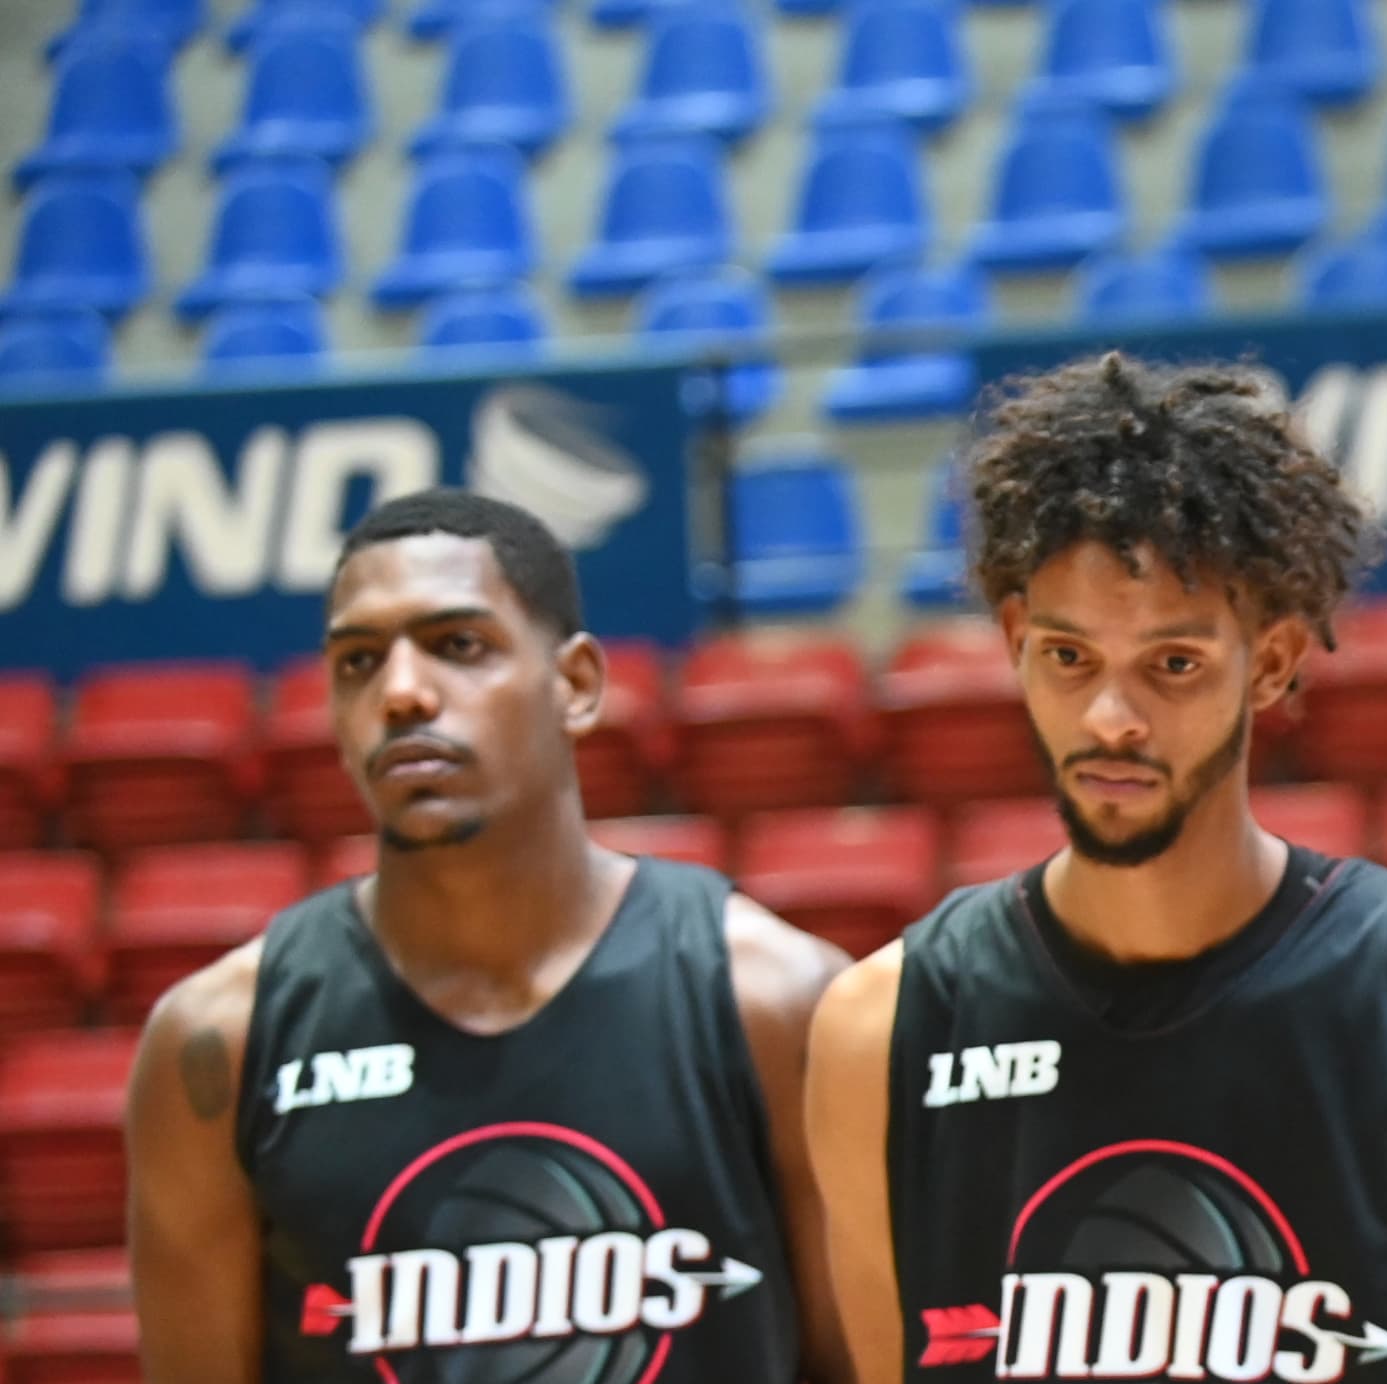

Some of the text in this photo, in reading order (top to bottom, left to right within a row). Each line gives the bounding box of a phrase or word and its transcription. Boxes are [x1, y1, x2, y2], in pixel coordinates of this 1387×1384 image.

[275, 1043, 416, 1114] LNB
[923, 1040, 1062, 1107] LNB
[348, 1229, 711, 1354] INDIOS
